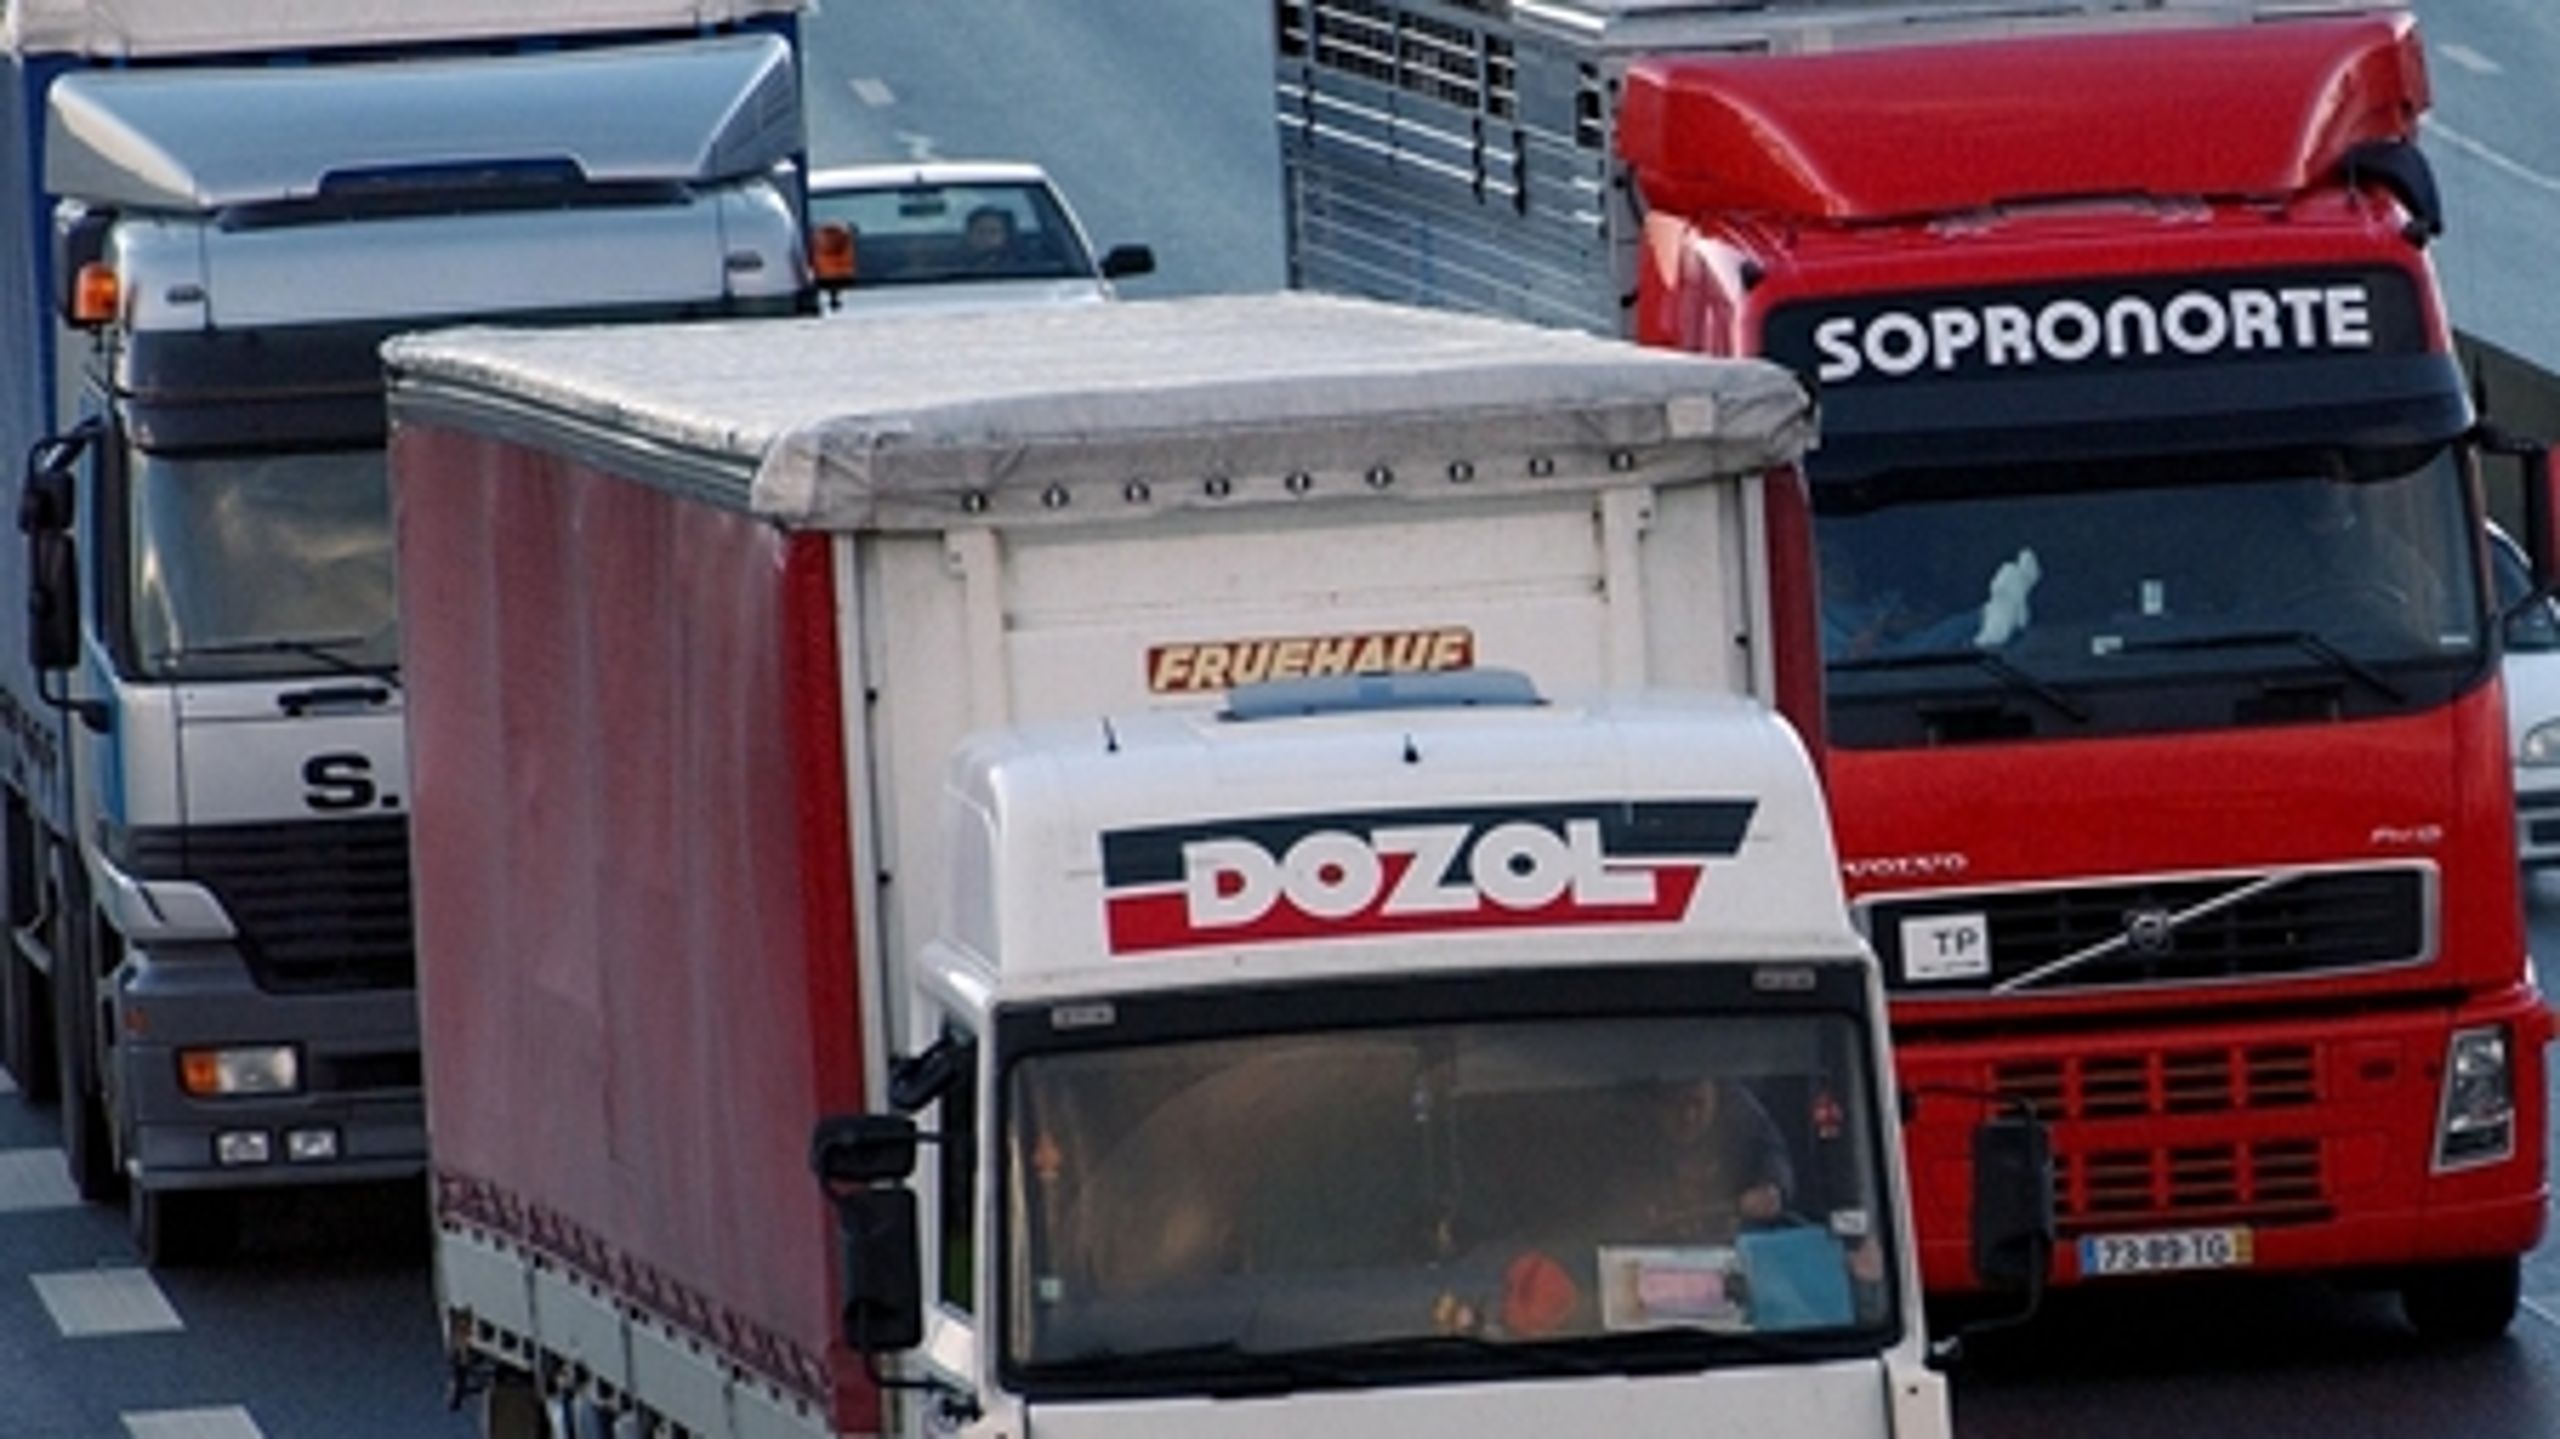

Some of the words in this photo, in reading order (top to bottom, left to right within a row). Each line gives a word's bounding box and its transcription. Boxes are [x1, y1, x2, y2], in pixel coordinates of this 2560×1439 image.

[1813, 286, 2372, 383] SOPRONORTE
[1154, 632, 1466, 689] FRUEHAUF
[302, 754, 400, 810] S.
[1182, 819, 1657, 929] DOZOL
[1842, 853, 1968, 878] VOLVO
[1932, 926, 1979, 957] TP
